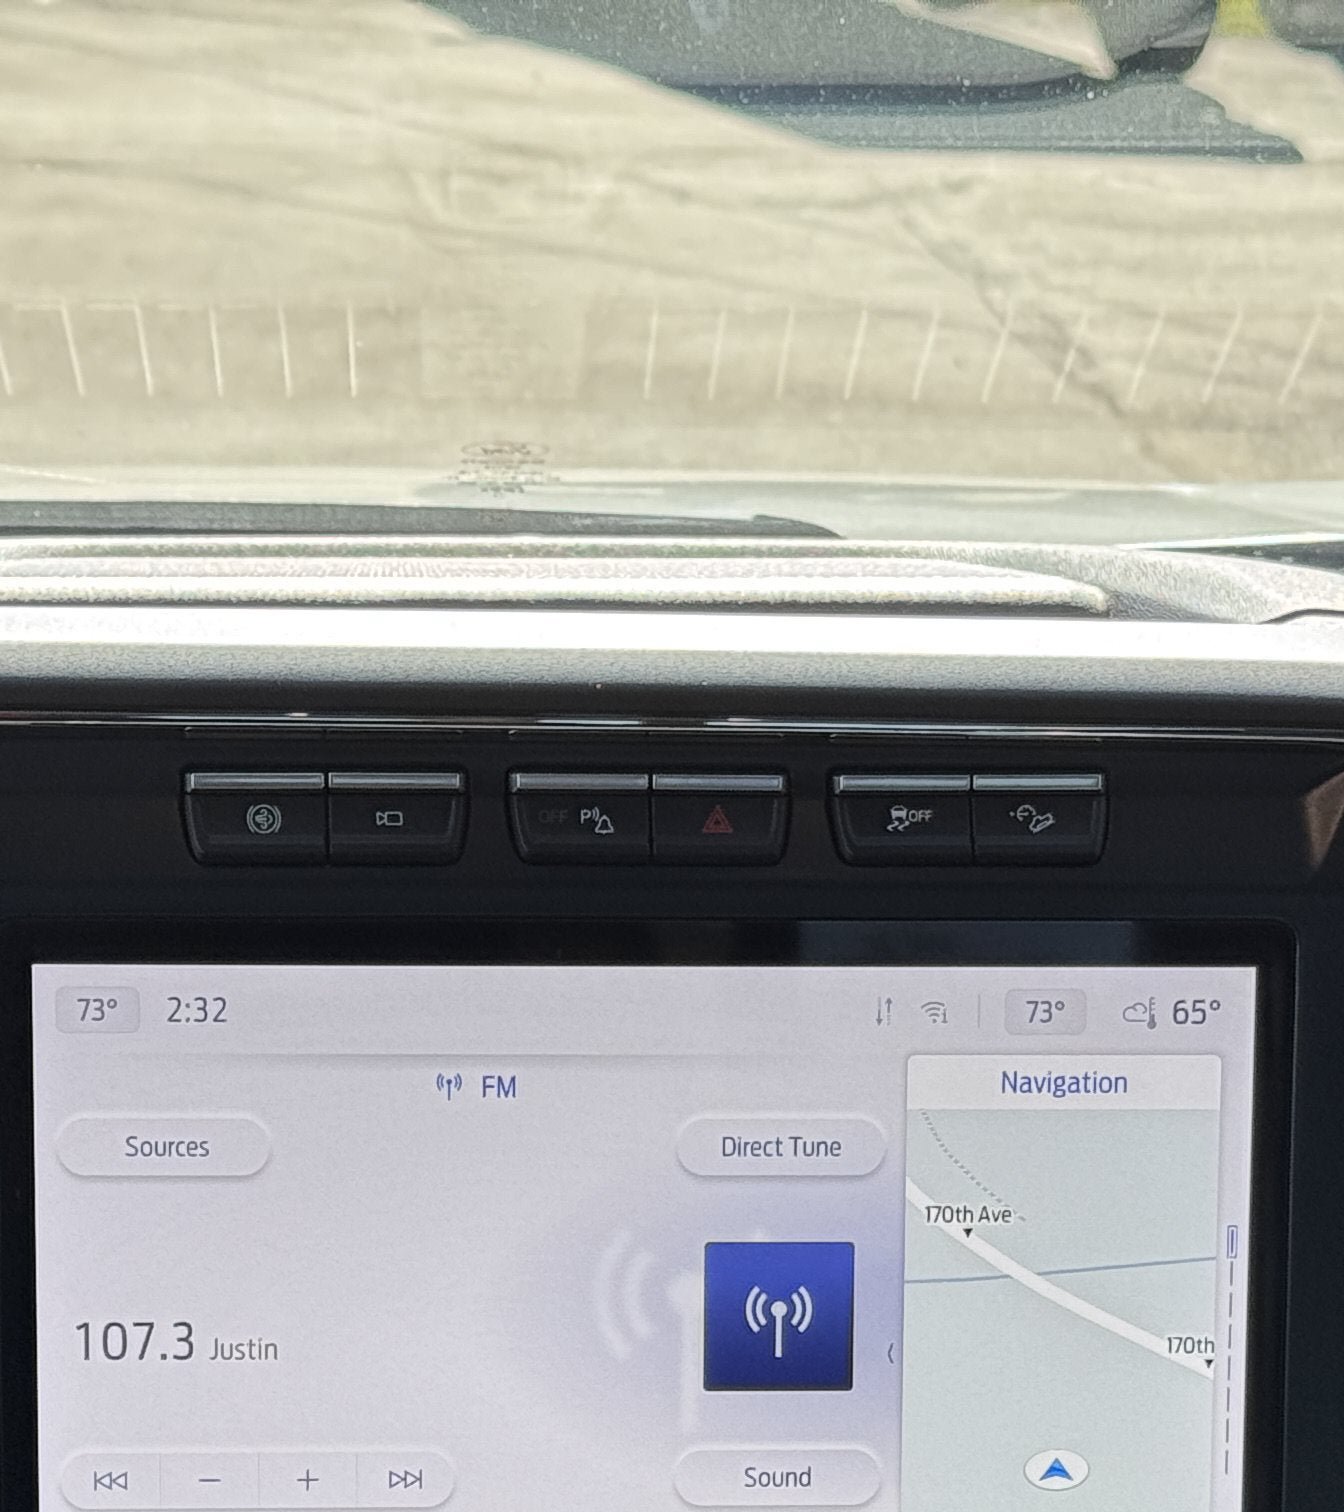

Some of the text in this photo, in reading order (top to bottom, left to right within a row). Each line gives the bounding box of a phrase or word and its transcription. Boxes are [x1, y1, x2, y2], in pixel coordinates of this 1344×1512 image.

[908, 809, 933, 823] OFF
[76, 998, 118, 1022] 73°
[166, 997, 228, 1023] 2:32
[1025, 1000, 1065, 1024] 73°
[1171, 999, 1221, 1025] 65°
[481, 1076, 517, 1098] FM
[1000, 1071, 1128, 1097] Navigation
[124, 1136, 210, 1158] Sources
[721, 1136, 842, 1158] Direct Tune
[925, 1206, 1012, 1224] 170th Ave
[75, 1322, 279, 1362] 107.3 Justin
[1166, 1336, 1215, 1355] 170th
[744, 1466, 813, 1489] Sound
